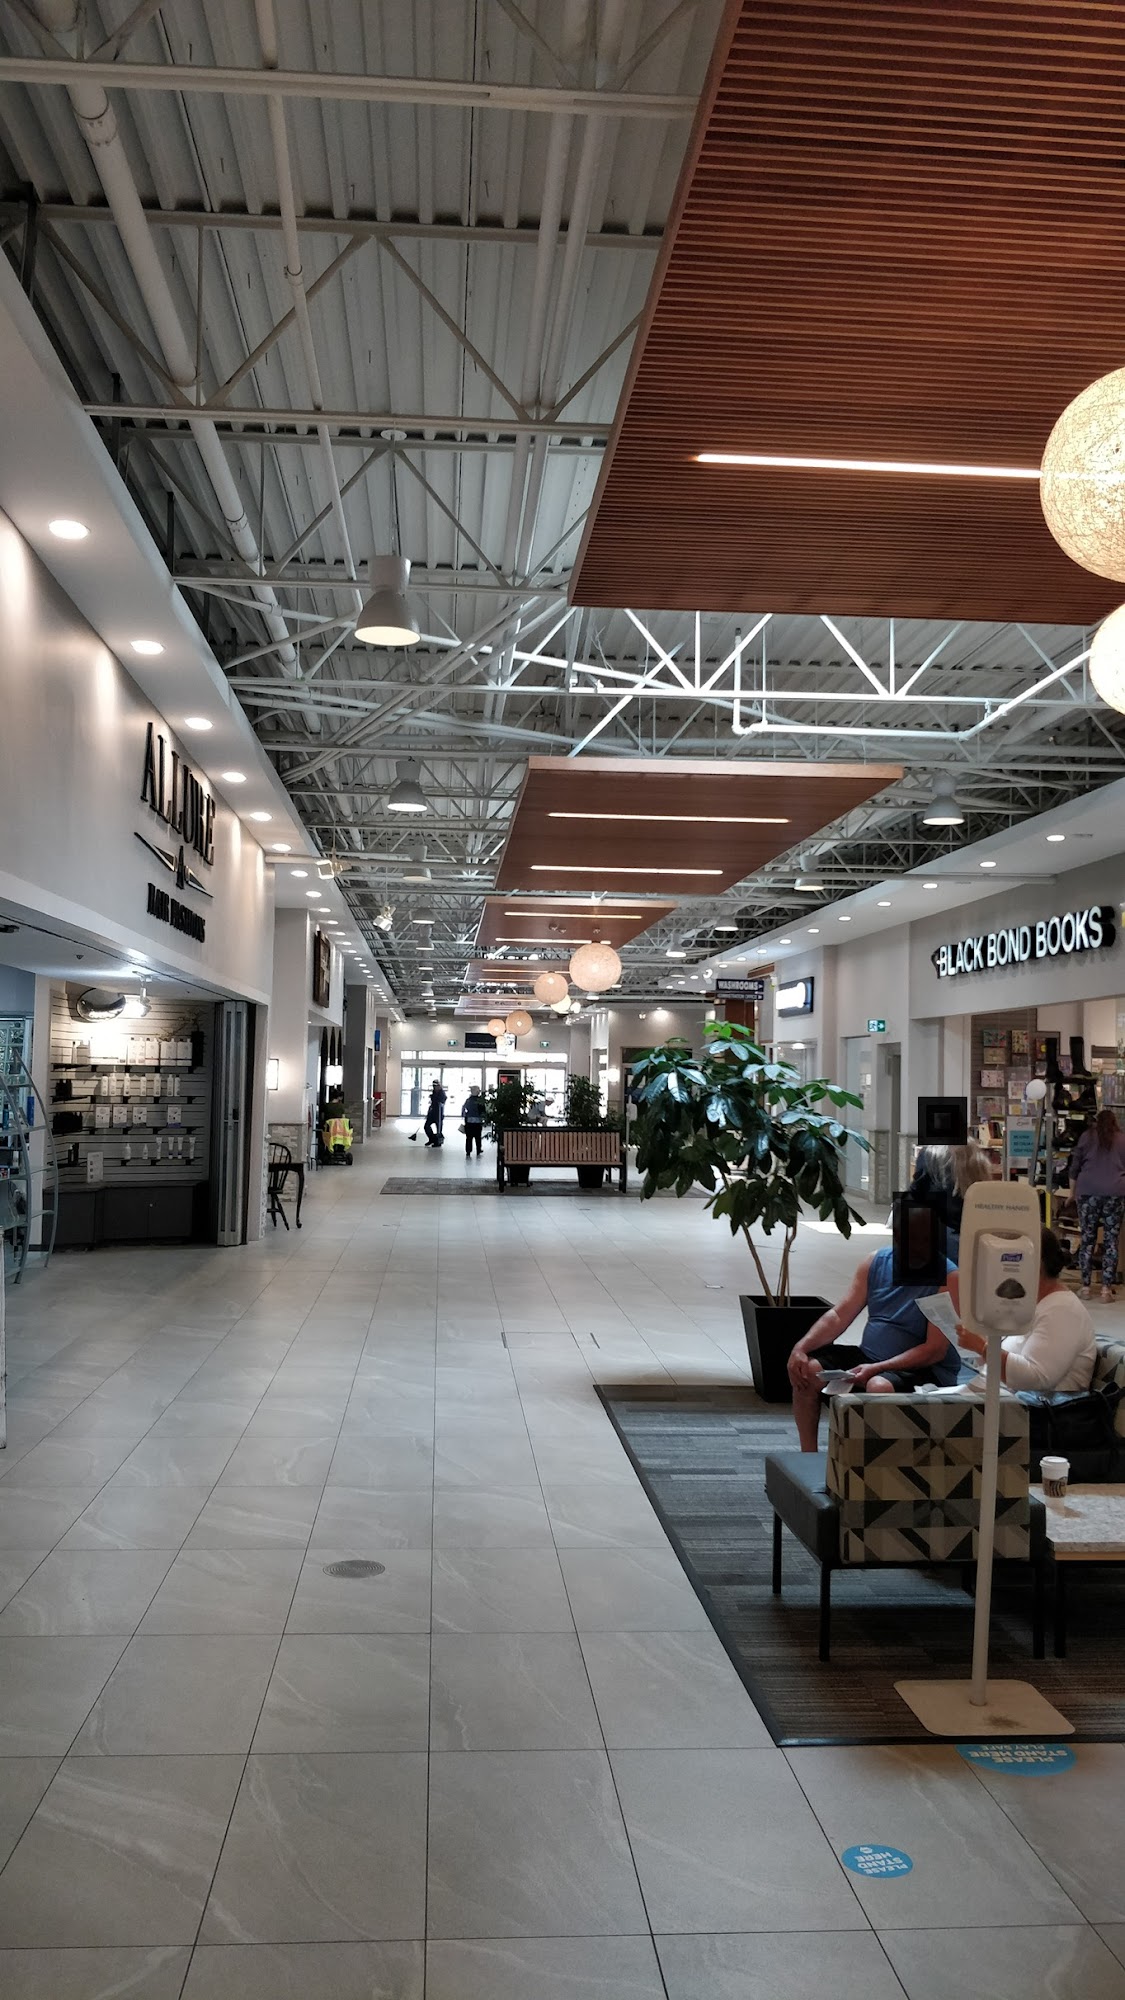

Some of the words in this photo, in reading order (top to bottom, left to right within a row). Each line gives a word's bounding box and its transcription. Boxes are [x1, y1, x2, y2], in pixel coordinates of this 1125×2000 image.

[140, 722, 216, 866] ALLURE
[939, 936, 985, 977] BLACK
[986, 925, 1031, 967] BOND
[1035, 905, 1103, 958] BOOKS
[718, 980, 758, 991] WASHROOMS
[975, 1203, 1004, 1211] HEALTHY
[968, 1750, 1013, 1758] HERE
[855, 1852, 893, 1863] HERE
[857, 1857, 903, 1869] STAND
[864, 1863, 909, 1875] PLEASE
